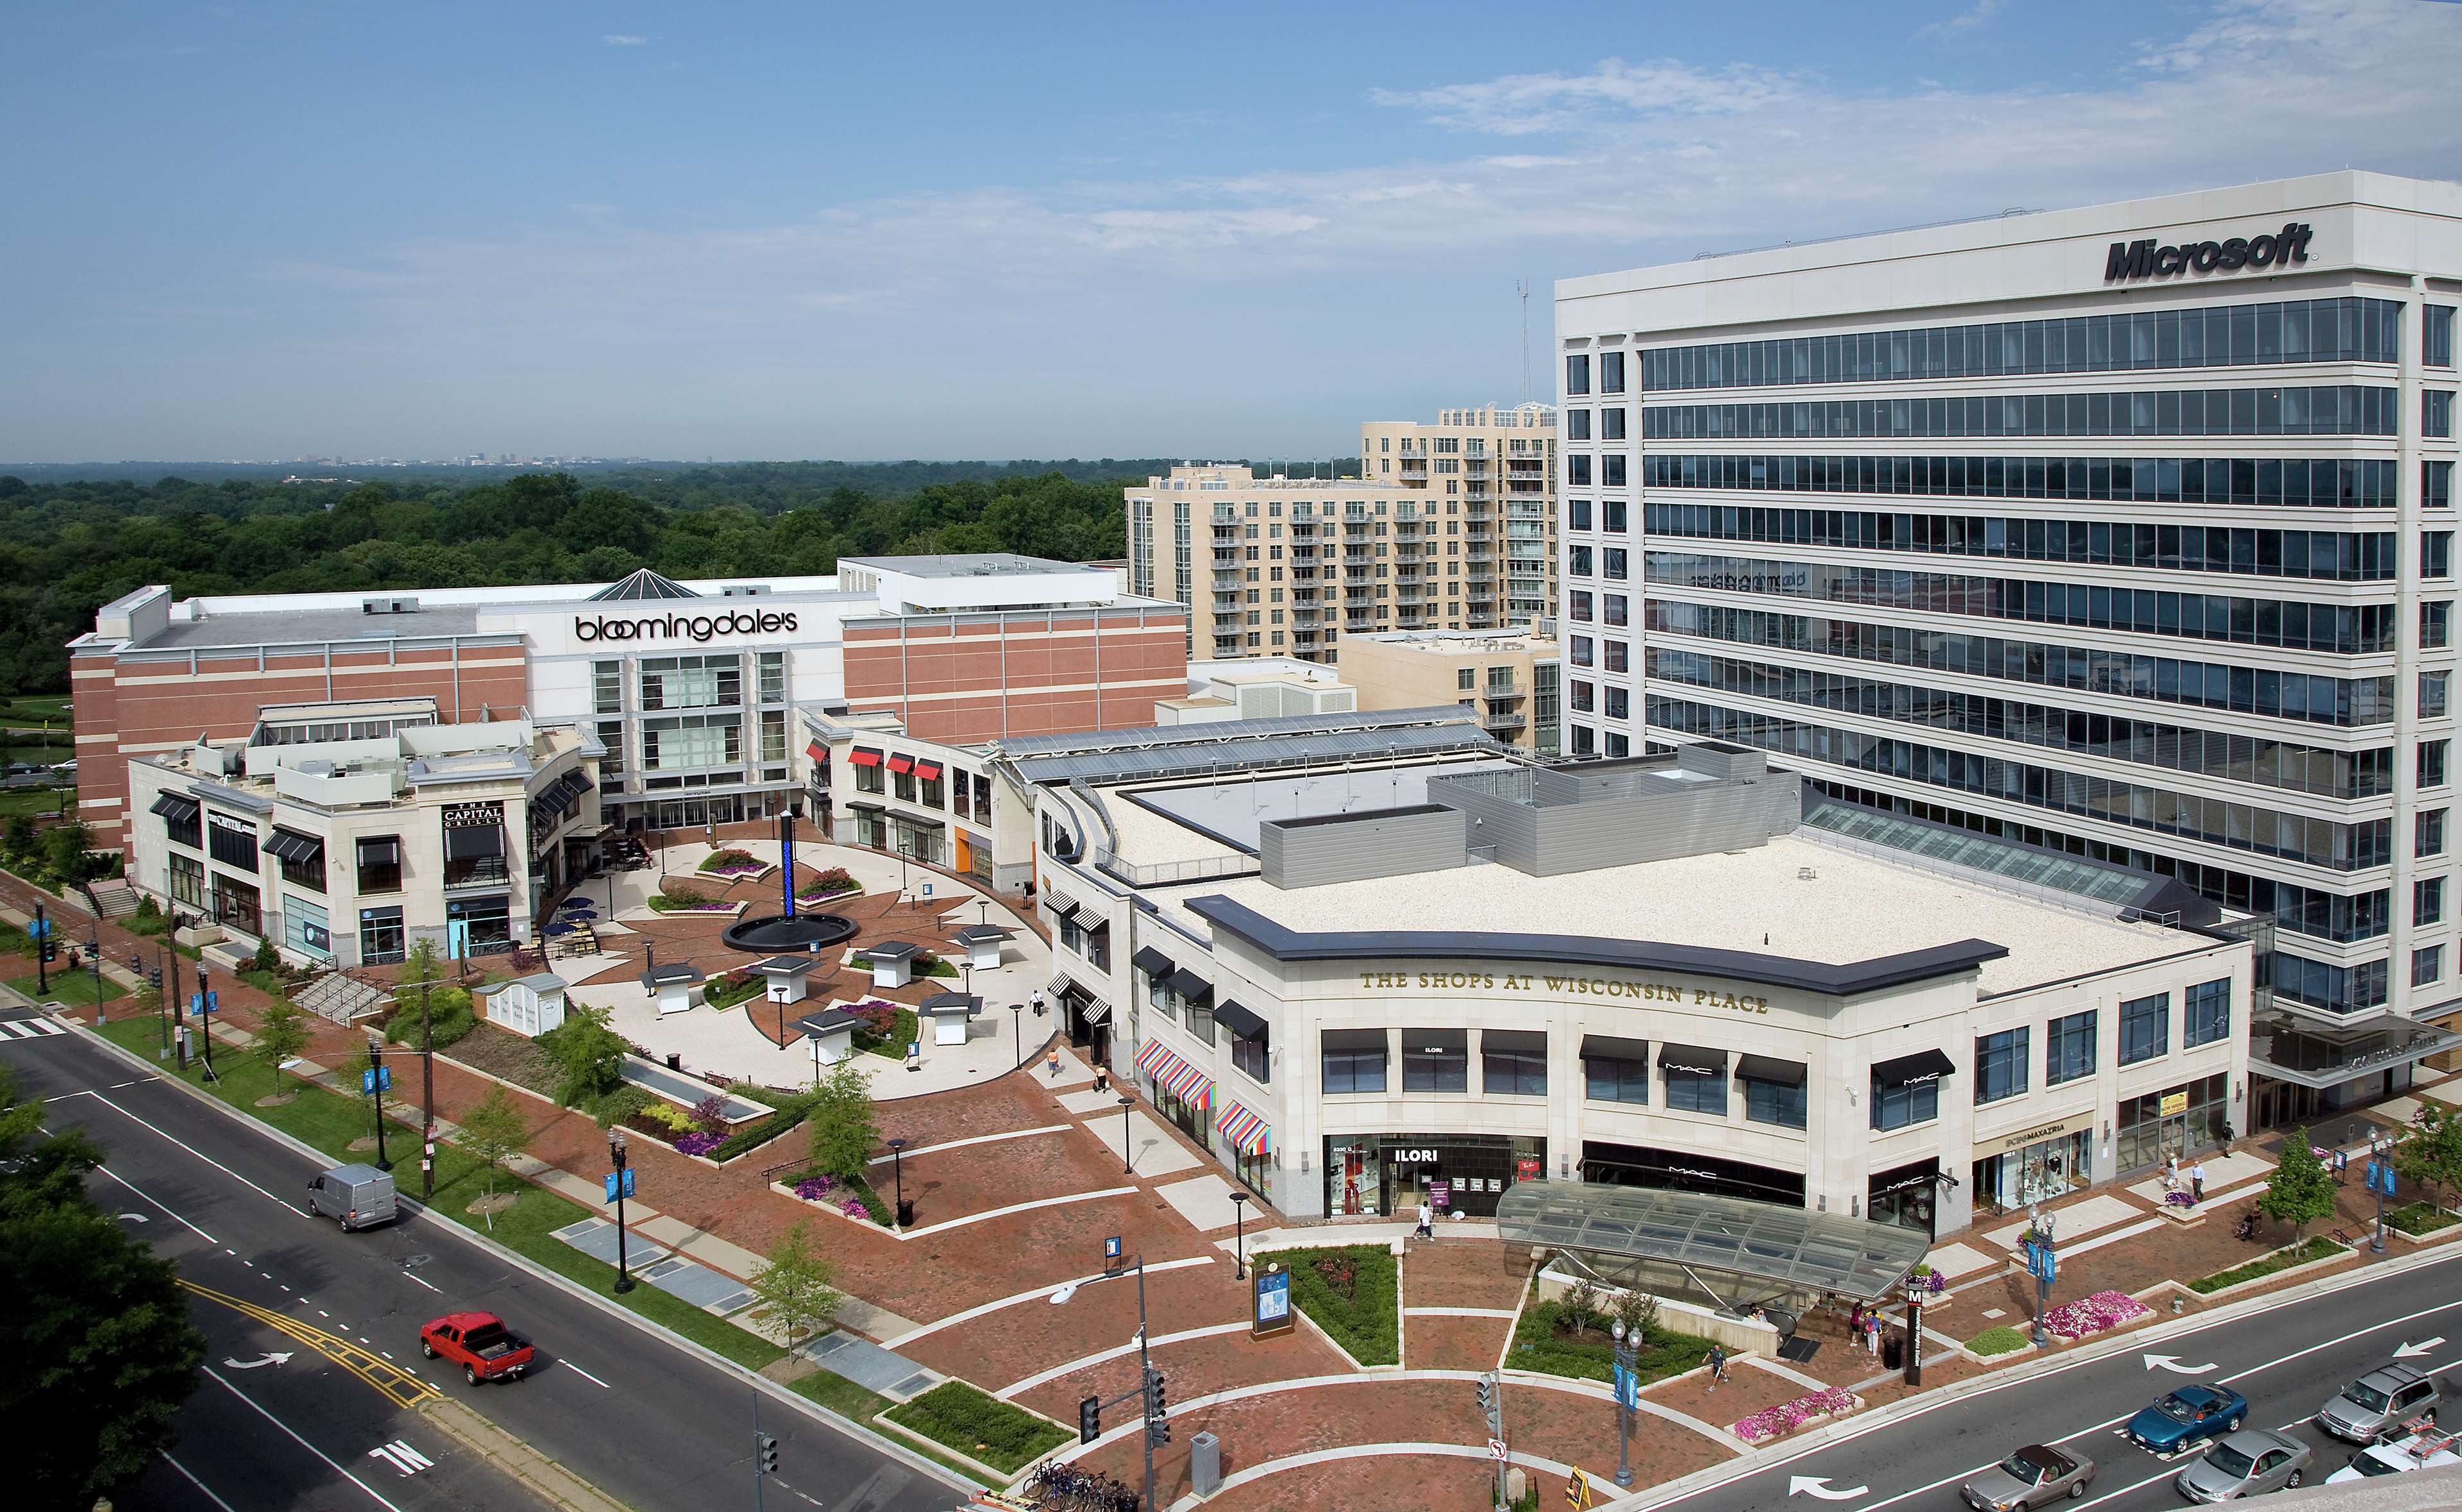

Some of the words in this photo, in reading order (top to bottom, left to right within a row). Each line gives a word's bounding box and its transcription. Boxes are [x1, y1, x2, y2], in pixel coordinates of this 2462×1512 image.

[2105, 223, 2313, 280] Microsoft
[575, 609, 797, 642] bloomingdale's
[444, 808, 501, 820] CAPITAL
[1360, 973, 1408, 988] THE
[1419, 972, 1494, 989] SHOPS
[1503, 974, 1534, 990] AT
[1542, 975, 1683, 1003] WISCONSIN
[1694, 989, 1768, 1014] PLACE
[1395, 1150, 1438, 1162] ILORI
[1909, 1290, 1921, 1302] M
